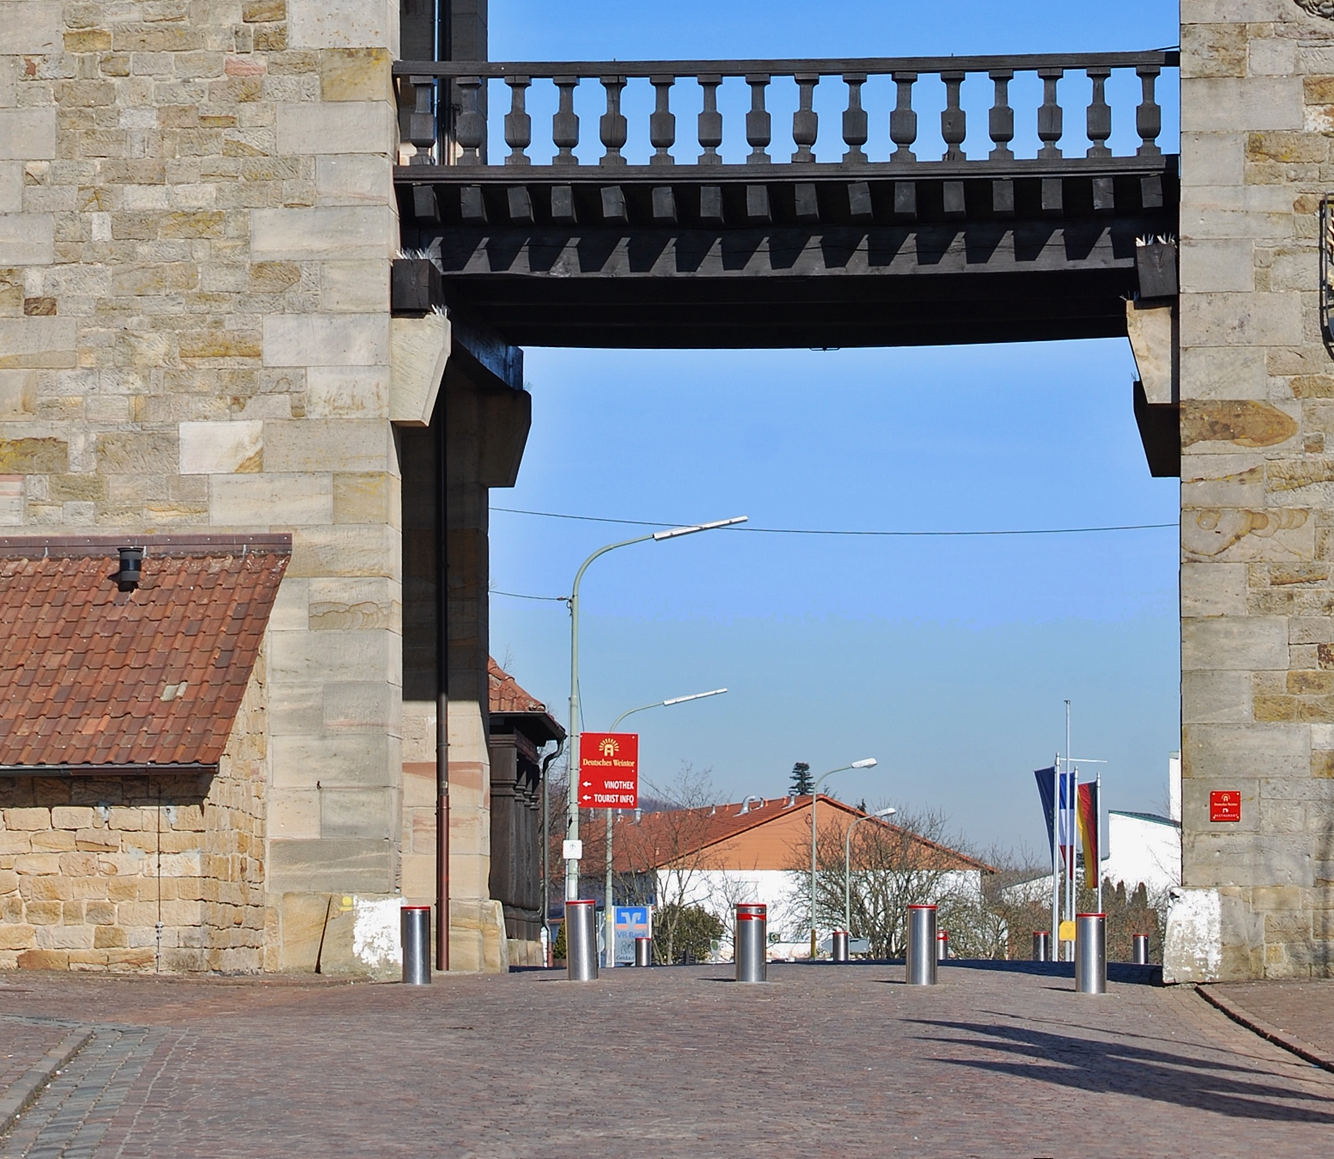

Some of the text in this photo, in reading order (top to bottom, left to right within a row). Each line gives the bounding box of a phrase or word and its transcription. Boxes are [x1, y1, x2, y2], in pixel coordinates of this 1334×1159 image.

[583, 758, 635, 767] Deutsches Weintor
[604, 781, 634, 789] VINOTHEK
[594, 794, 635, 803] TOURIST INFO
